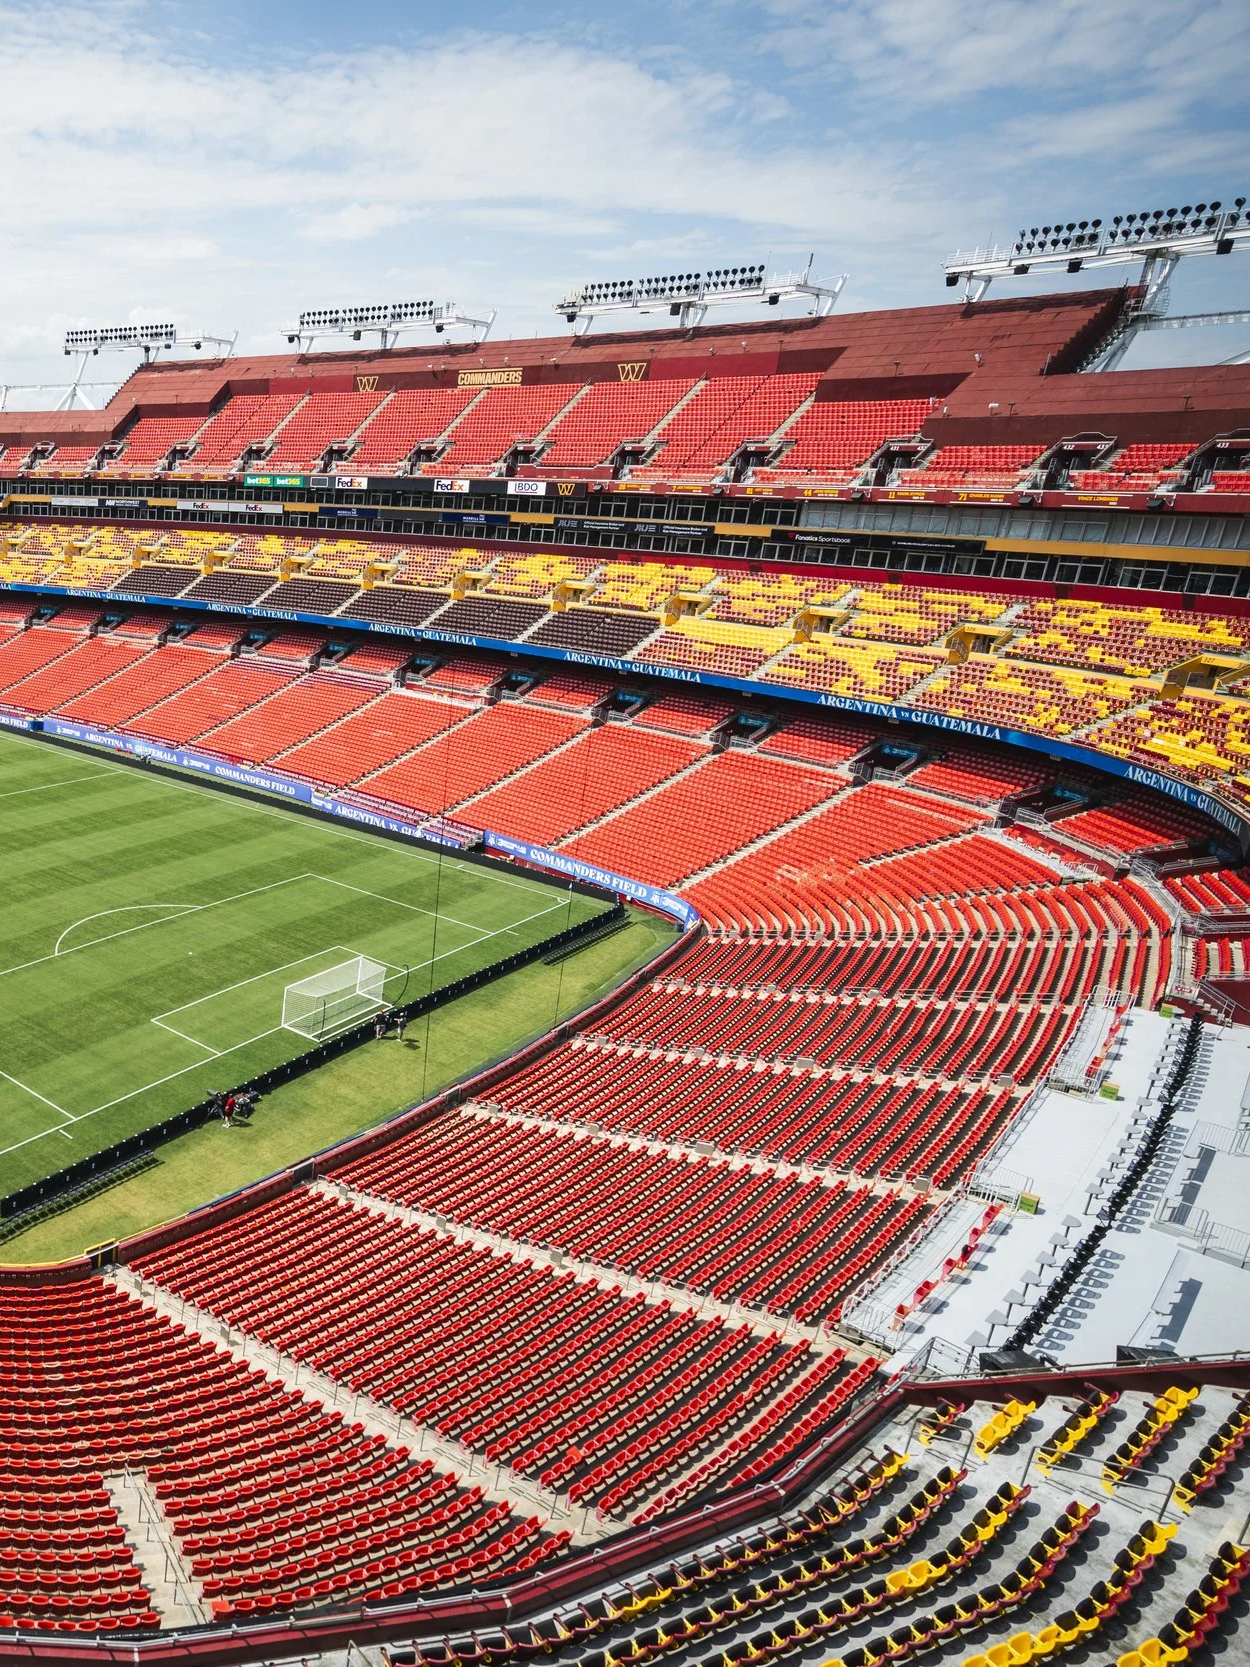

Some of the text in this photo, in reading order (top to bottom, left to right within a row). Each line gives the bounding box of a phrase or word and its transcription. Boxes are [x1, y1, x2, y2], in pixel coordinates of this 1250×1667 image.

[458, 370, 522, 385] COMMANDERS
[247, 477, 270, 485] bet365
[276, 478, 300, 486] bet365
[337, 478, 362, 488] FedEx
[436, 480, 463, 491] FedEx
[193, 502, 209, 510] FedEx
[246, 504, 262, 512] FedEx
[818, 536, 850, 544] Sportsbook
[66, 589, 101, 598] ARGENTINA
[106, 592, 146, 602] GUATEMALA
[207, 603, 247, 615] ARGENTINA
[252, 608, 297, 620] GUATEMALA
[368, 623, 415, 637] ARGENTINA
[422, 631, 476, 646] GUATEMALA
[564, 652, 622, 670] ARGENTINA
[632, 662, 700, 682] GUATEMALA
[10, 720, 28, 728] FIELD
[816, 694, 1000, 740] ARGENTINA VS GUATEMALA
[85, 732, 123, 748] ARGENTINA
[135, 744, 177, 762] GUATEMALA
[215, 766, 295, 795] COMMANDERS FIELD
[1124, 765, 1241, 836] ARGENTINA VS GUATEMALA
[335, 805, 385, 829] ARGENTINA
[497, 838, 504, 846] 3
[530, 849, 647, 897] COMMANDERS FIELD
